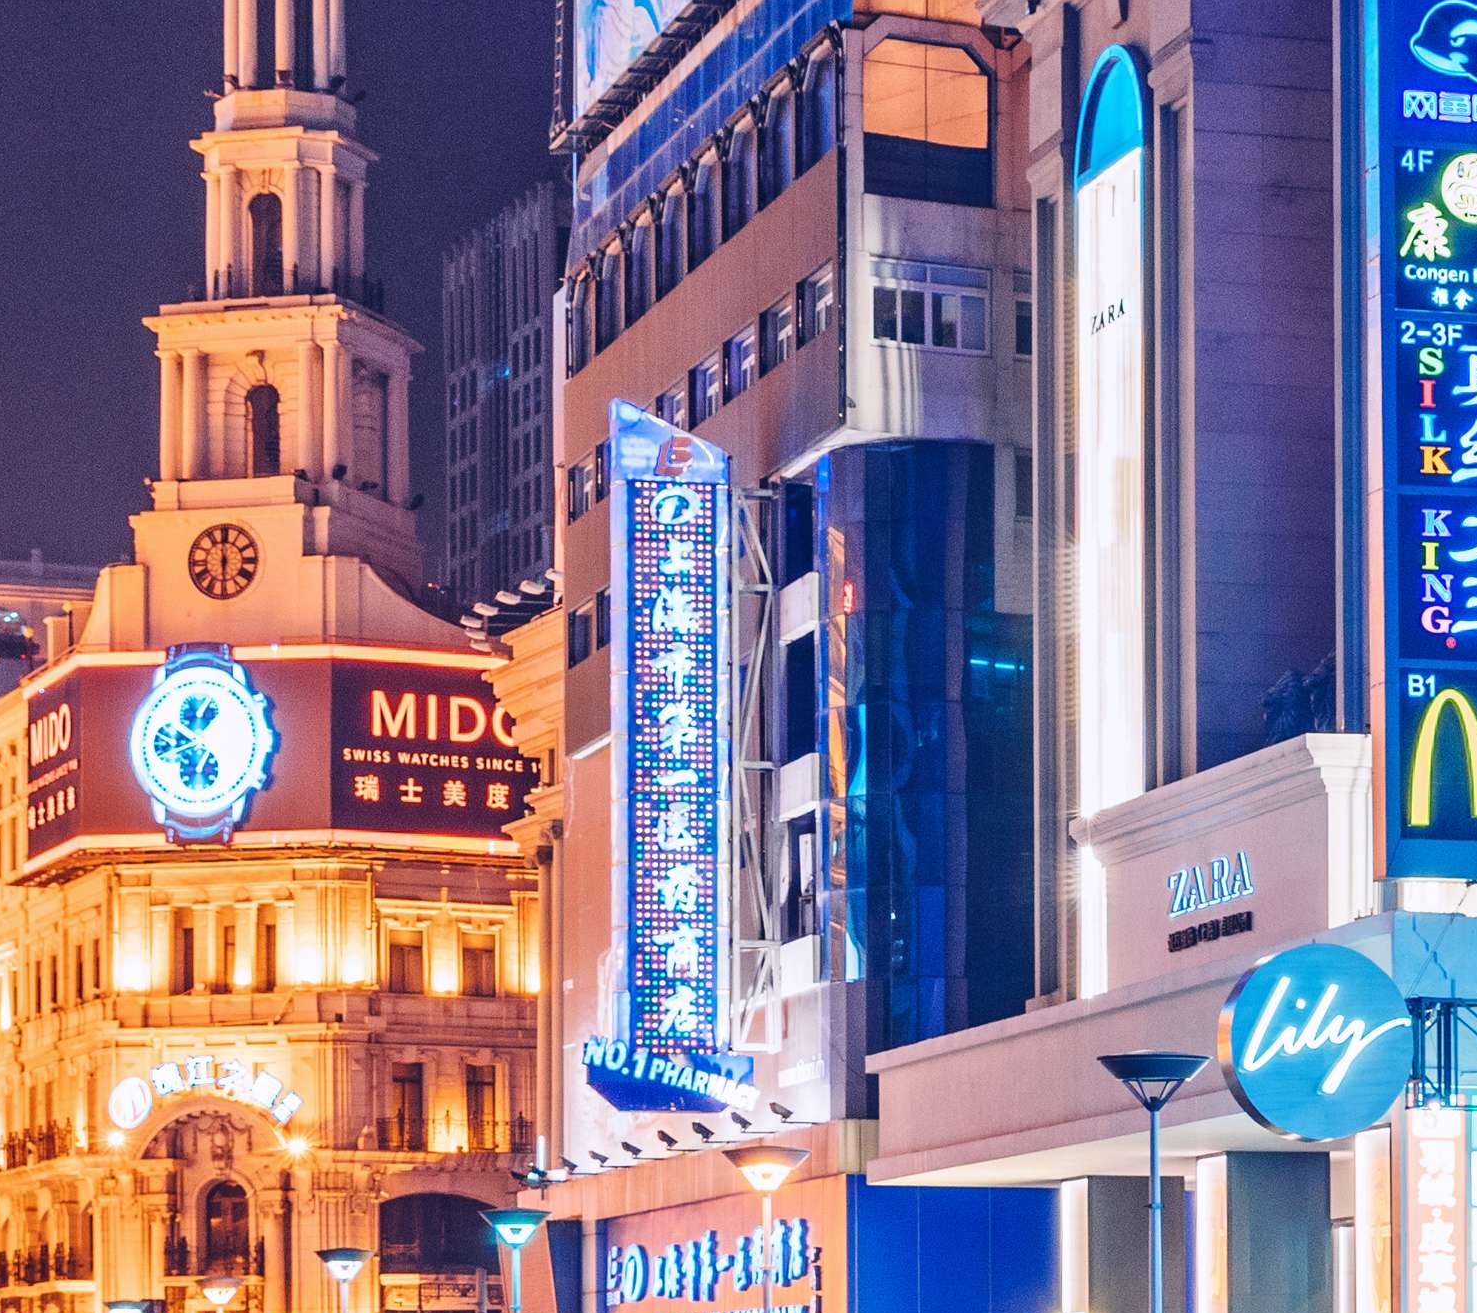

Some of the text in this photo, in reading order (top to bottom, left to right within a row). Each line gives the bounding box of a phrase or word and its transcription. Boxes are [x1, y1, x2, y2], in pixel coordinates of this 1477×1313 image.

[1400, 150, 1434, 173] 4F
[1404, 264, 1469, 285] Congen
[1090, 297, 1127, 337] ZARA
[1400, 322, 1464, 345] 2-3F
[1407, 674, 1436, 698] B1
[30, 702, 72, 767] MIDO
[342, 747, 392, 764] SWISS
[397, 751, 470, 769] WATCHES
[475, 757, 524, 773] SINCE
[354, 774, 542, 818] 瑞士美度
[1167, 850, 1255, 919] ZARA
